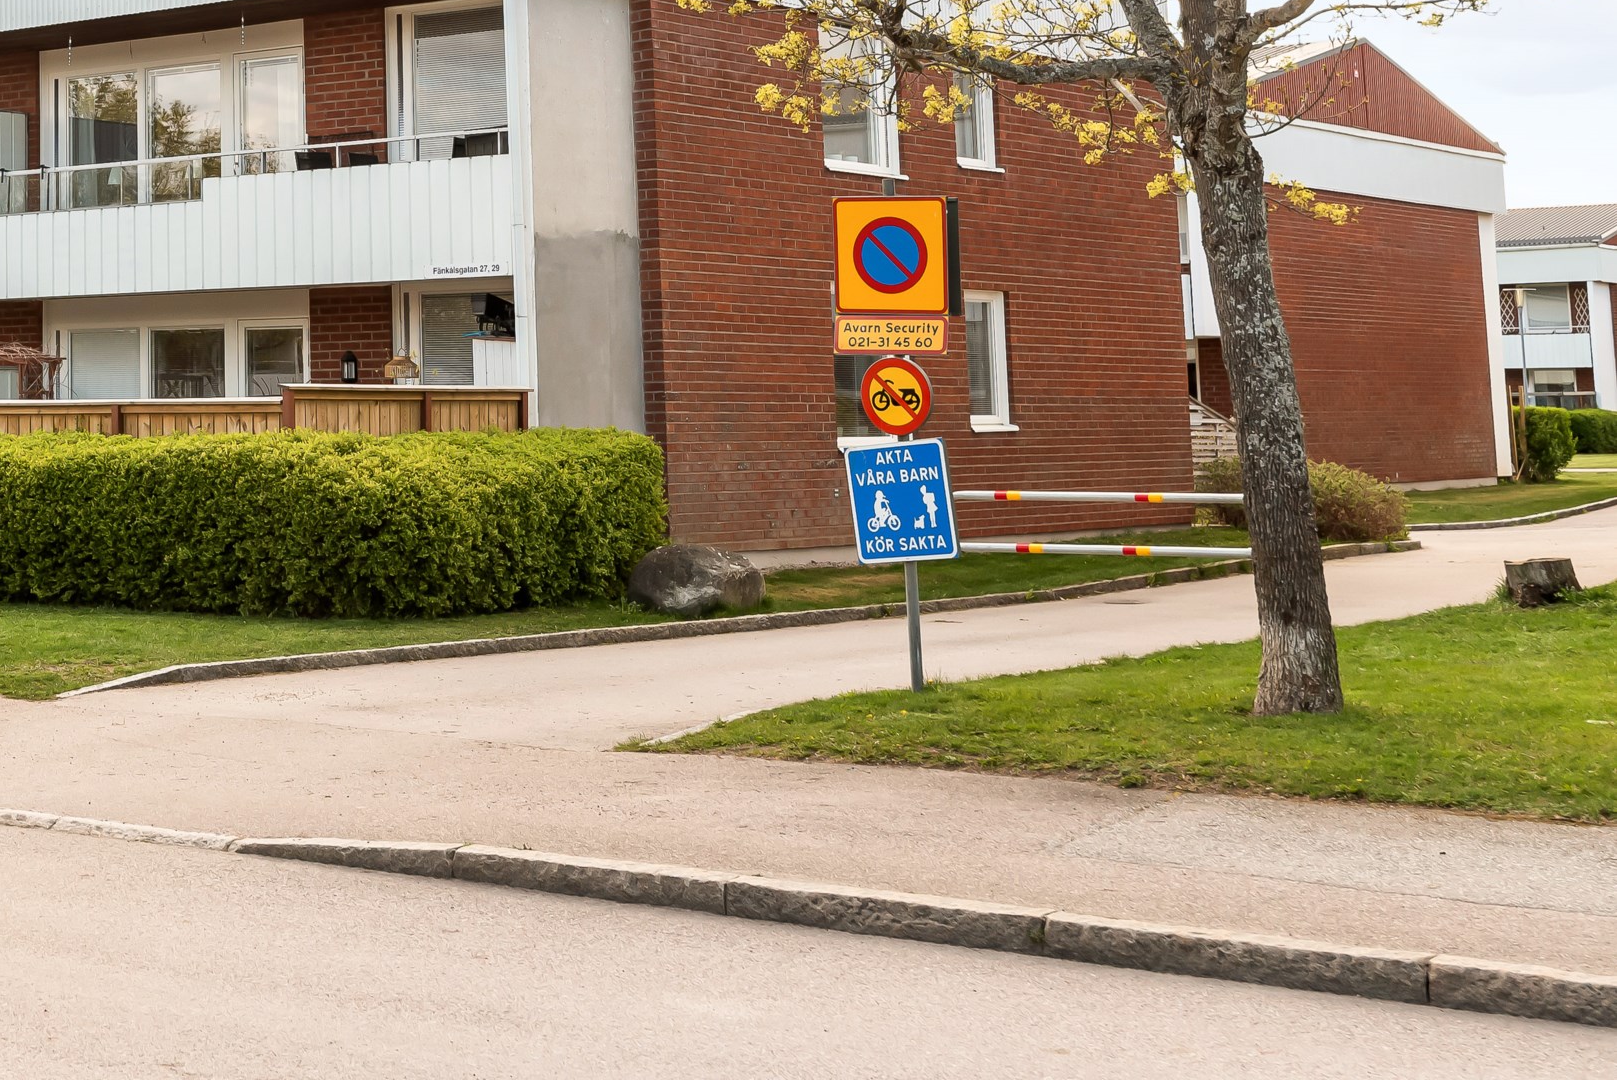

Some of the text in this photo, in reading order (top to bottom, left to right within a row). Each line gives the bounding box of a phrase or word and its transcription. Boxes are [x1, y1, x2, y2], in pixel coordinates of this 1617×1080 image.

[432, 264, 500, 276] Fänkålsgatan 27, 29
[843, 322, 939, 336] Avarn Security
[848, 336, 933, 348] 021-31 45 60
[875, 448, 913, 465] AKTA
[855, 465, 939, 487] VÅRA BARN
[865, 534, 947, 554] KÖR SAKTA
